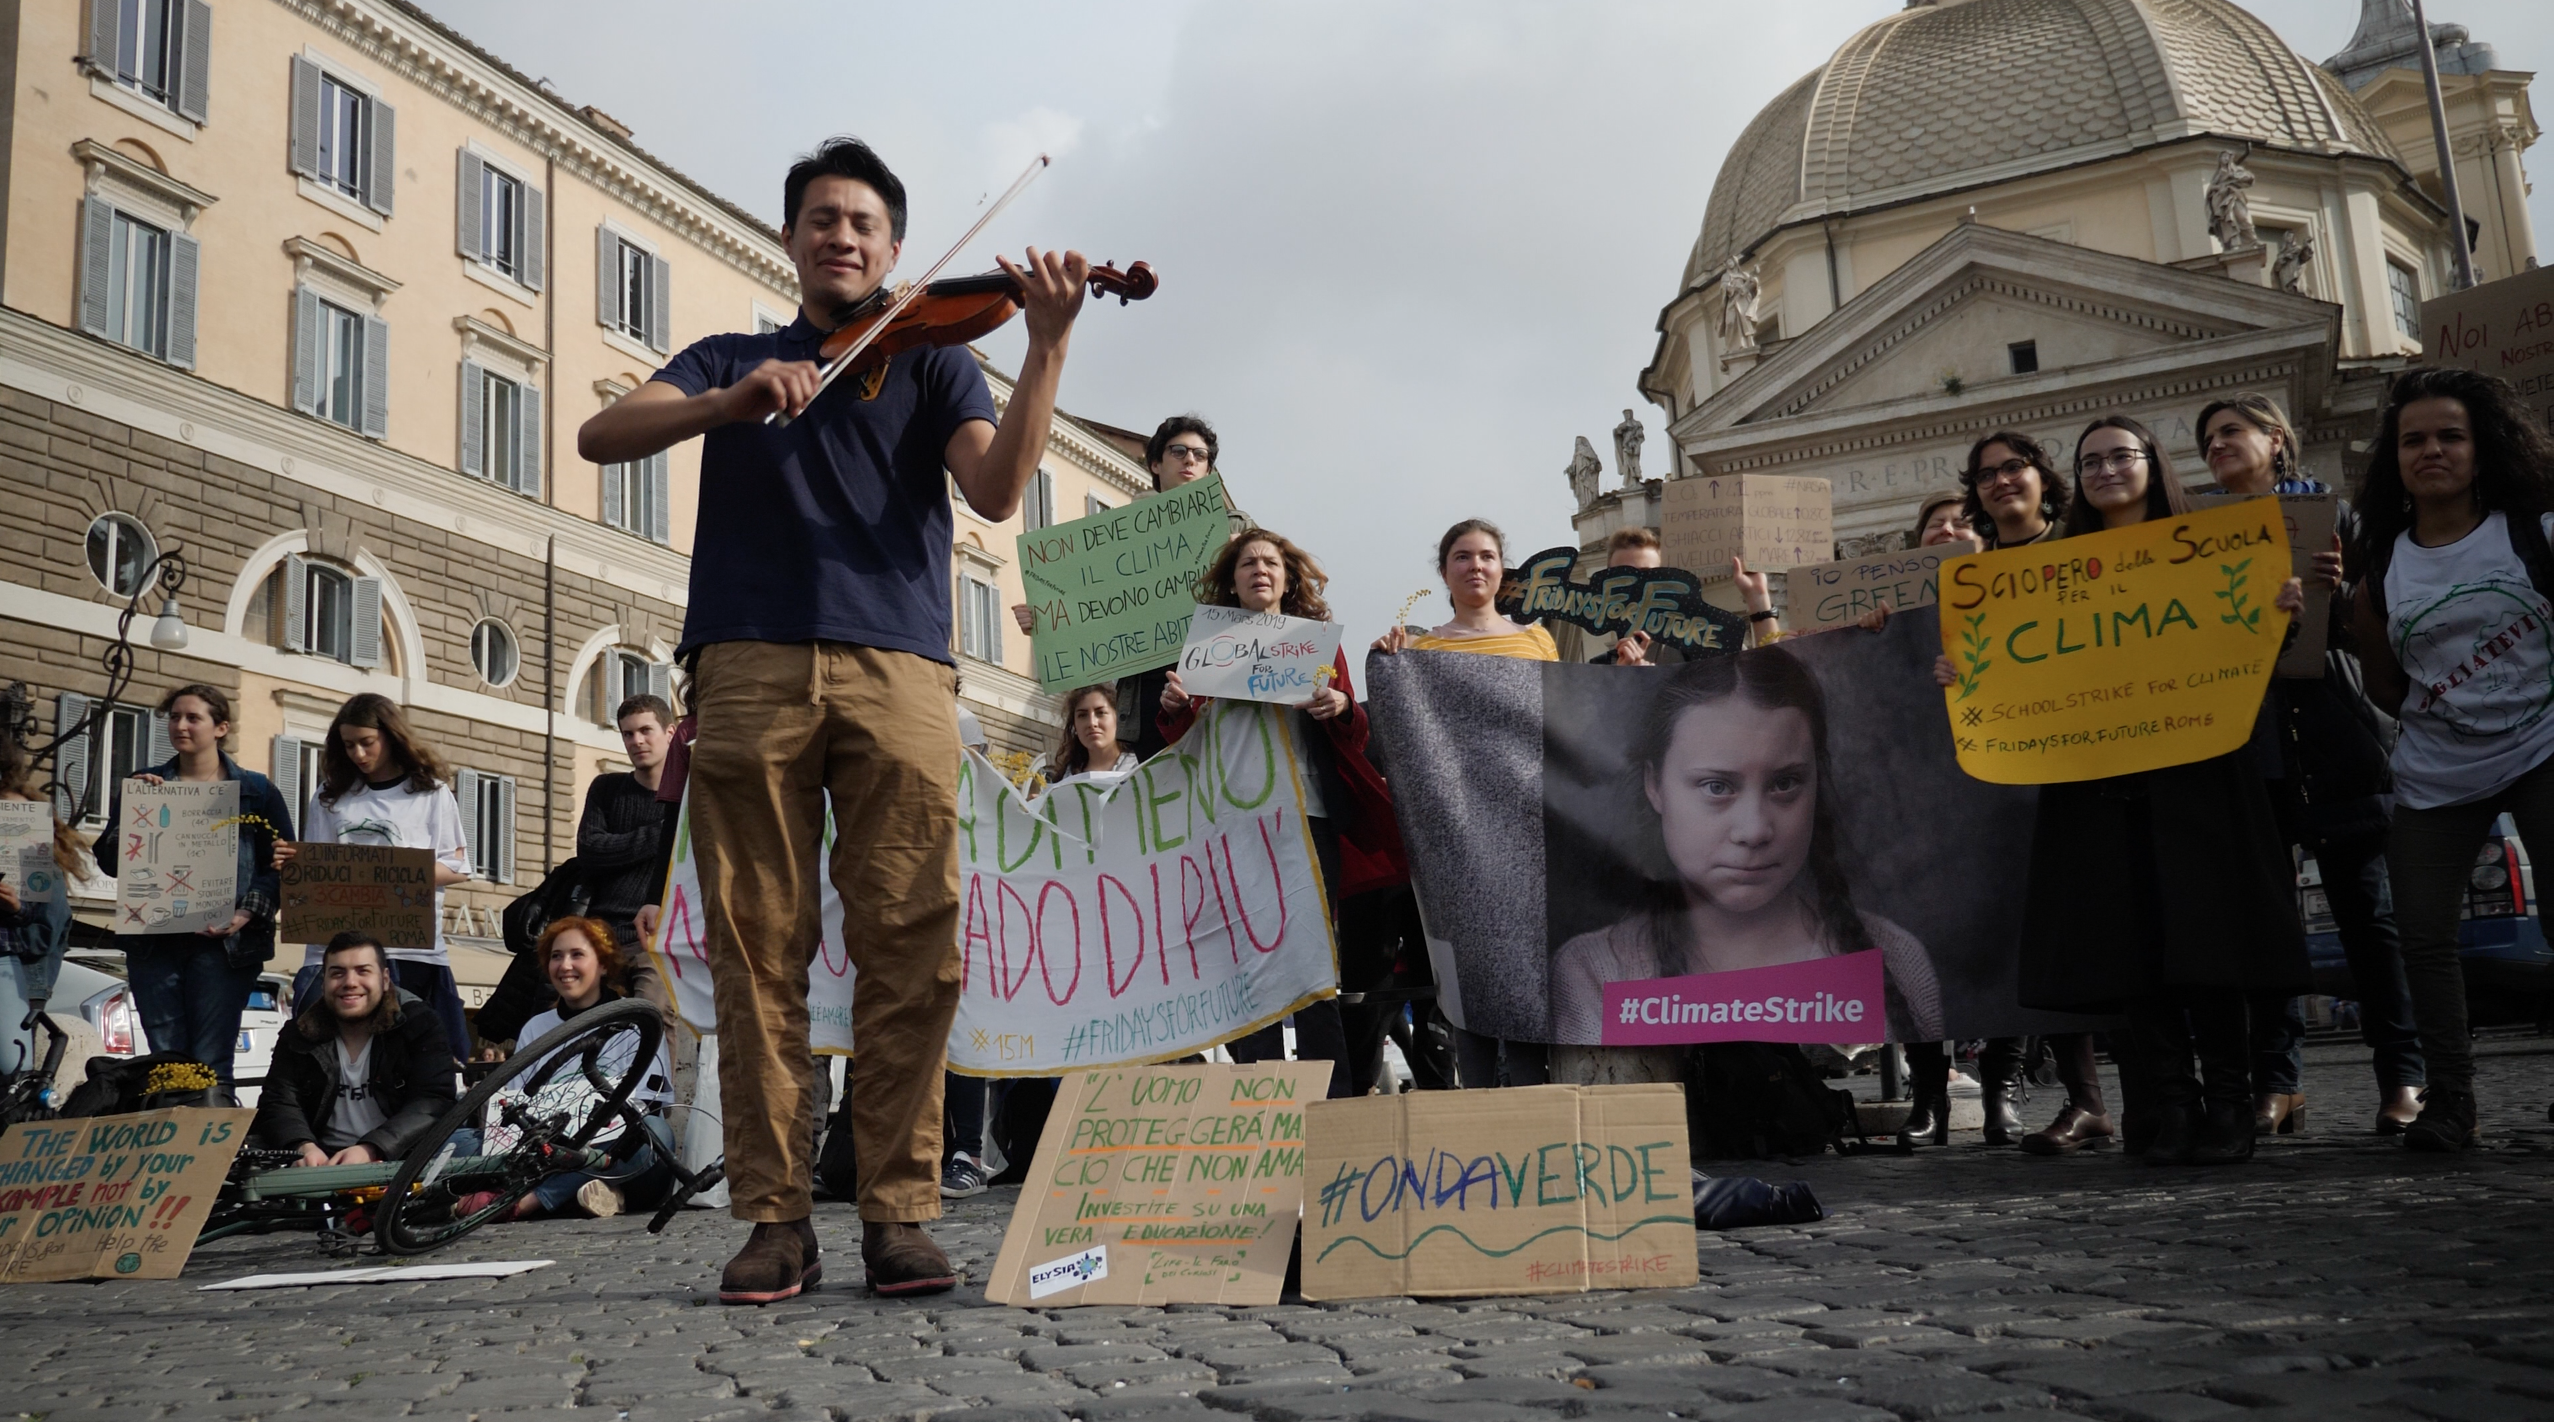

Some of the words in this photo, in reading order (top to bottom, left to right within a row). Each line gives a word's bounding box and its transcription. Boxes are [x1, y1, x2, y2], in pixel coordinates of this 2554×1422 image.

[2439, 311, 2487, 359] NOI
[1783, 478, 1828, 494] #NASA
[1027, 533, 1074, 568] NON
[1082, 515, 1129, 551] DEVE
[1134, 481, 1223, 534] CAMBIARE
[1663, 505, 1744, 524] TEMPERATURA
[1748, 505, 1792, 520] GLOBALE
[1664, 529, 1722, 548] GHIACCI
[1729, 526, 1771, 542] ARTICI
[1081, 565, 1104, 587] IL
[1115, 532, 1193, 577] CLIMA
[1666, 550, 1724, 568] LIVELLO
[1758, 548, 1791, 563] MARE
[1852, 555, 1940, 581] PENSO
[1951, 556, 2102, 610] SCIOPERO
[2168, 524, 2274, 565] SCUOLA
[1816, 571, 1939, 622] GREEN
[2057, 589, 2090, 605] PER
[2110, 583, 2128, 596] IL
[1034, 598, 1071, 635] MA
[1078, 587, 1149, 624] DEVONO
[1202, 608, 1220, 620] 15
[1256, 614, 1287, 630] 2019
[2006, 598, 2198, 665] CLIMA
[1044, 651, 1074, 683] LE
[1080, 630, 1149, 672] NOSTRE
[1153, 613, 1194, 652] ABIT
[1185, 638, 1272, 671] GLOBAL
[1252, 664, 1273, 675] FOR
[2148, 677, 2178, 695] FOR
[2186, 658, 2265, 688] CLIMATE
[127, 783, 200, 796] L'ALTERNATIVA
[181, 808, 223, 818] BORRACCIA
[175, 832, 219, 841] CANNUCCIA
[191, 839, 227, 848] METALLO
[323, 846, 394, 863] INFORMATI
[201, 877, 234, 889] EVITARE
[303, 864, 352, 882] RIDUCI
[373, 866, 427, 884] RICICLA
[195, 898, 233, 909] MONOUSO
[197, 887, 232, 899] STOVIGLIE
[328, 886, 386, 903] CAMBIA
[282, 907, 423, 938] #FRIDAYSFORFUTURE
[1097, 861, 1169, 1000] DI
[388, 930, 427, 945] ROMA
[1061, 972, 1261, 1063] #FRIDAYSFORFUTURE
[1619, 991, 1864, 1025] #ClimateStrike
[1131, 1075, 1202, 1106] UOMO
[1229, 1077, 1297, 1101] NON
[22, 1128, 77, 1158] THE
[88, 1121, 178, 1154] WORLD
[100, 1154, 129, 1181] by
[1122, 1154, 1179, 1183] CHE
[1186, 1154, 1249, 1183] NON
[90, 1179, 133, 1205] not
[139, 1177, 172, 1207] by
[1317, 1140, 1679, 1229] #ONDAVERDE
[1076, 1191, 1180, 1222] INVESTITE
[1192, 1202, 1221, 1218] SU
[1230, 1202, 1267, 1218] UNA
[95, 1233, 135, 1254] Help
[139, 1233, 169, 1253] the
[1045, 1226, 1093, 1247] VERA
[1525, 1253, 1673, 1283] #CLIMATESTRIKE
